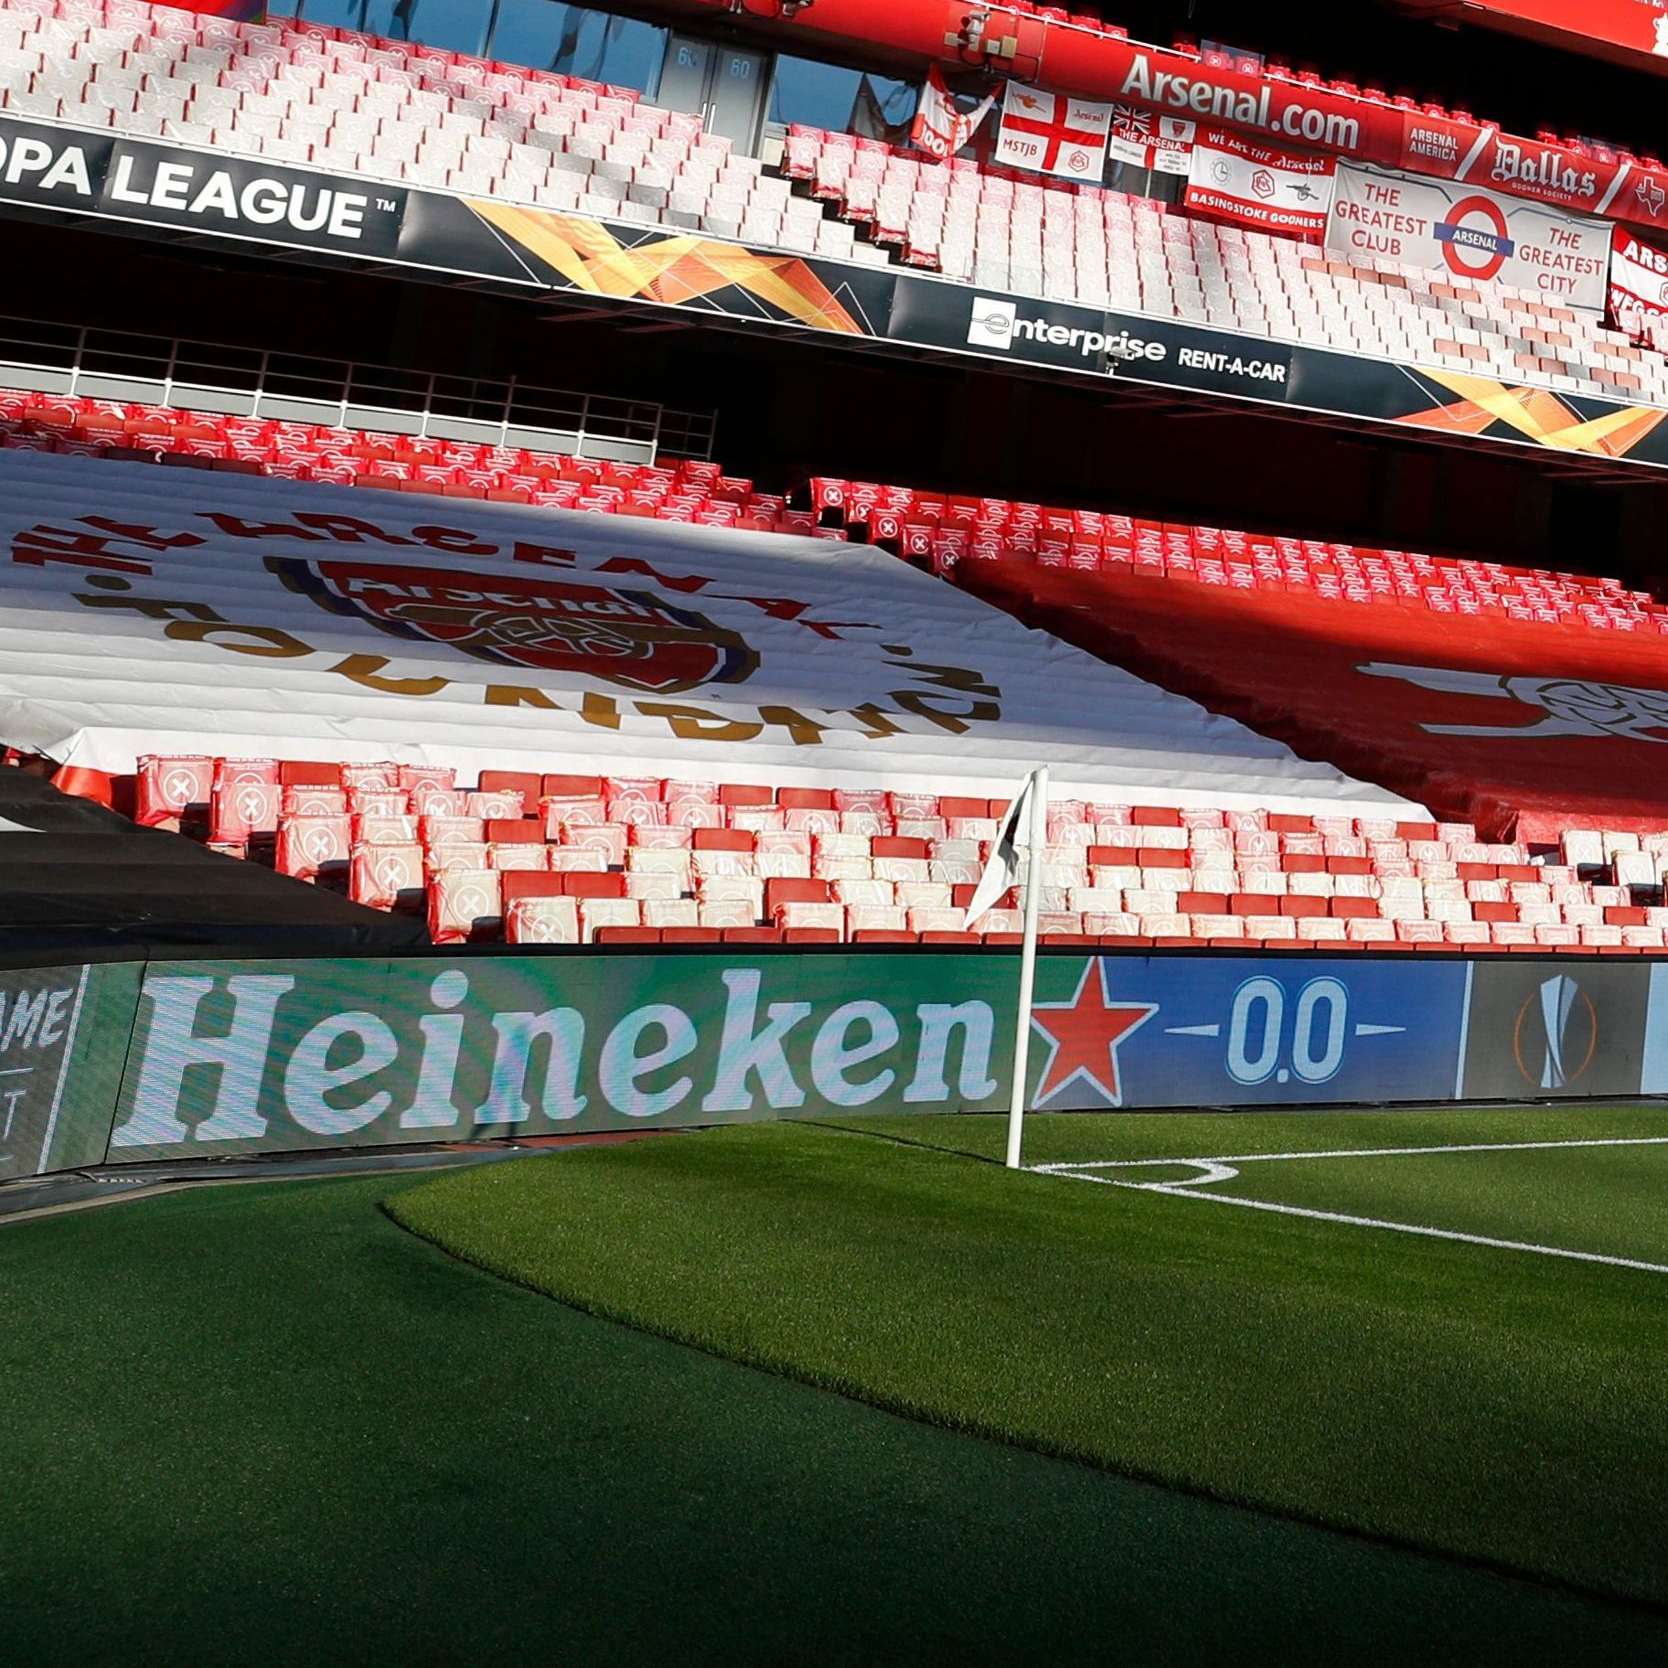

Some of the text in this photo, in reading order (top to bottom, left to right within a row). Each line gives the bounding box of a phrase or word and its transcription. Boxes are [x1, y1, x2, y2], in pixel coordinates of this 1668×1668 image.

[1120, 53, 1360, 150] Arsenal.com
[1003, 138, 1038, 156] MSTJB
[1119, 128, 1138, 143] THE
[1208, 132, 1226, 146] WE
[1250, 147, 1272, 161] THE
[1410, 128, 1458, 149] ARSENAL
[1408, 141, 1457, 161] AMERICA
[1490, 137, 1595, 197] Dallas
[109, 154, 368, 238] LEAGUE
[1364, 182, 1401, 207] THE
[1190, 192, 1324, 229] BASINGSTOKE GOONERS
[1335, 200, 1428, 236] GREATEST
[1351, 229, 1401, 256] CLUB
[1452, 229, 1498, 252] ARSENAL
[1550, 227, 1581, 250] THE
[1519, 245, 1604, 276] GREATEST
[1537, 273, 1578, 294] CITY
[1178, 347, 1286, 383] RENT-A-CAR
[1225, 973, 1350, 1086] 0.0
[109, 968, 998, 1148] Heineken
